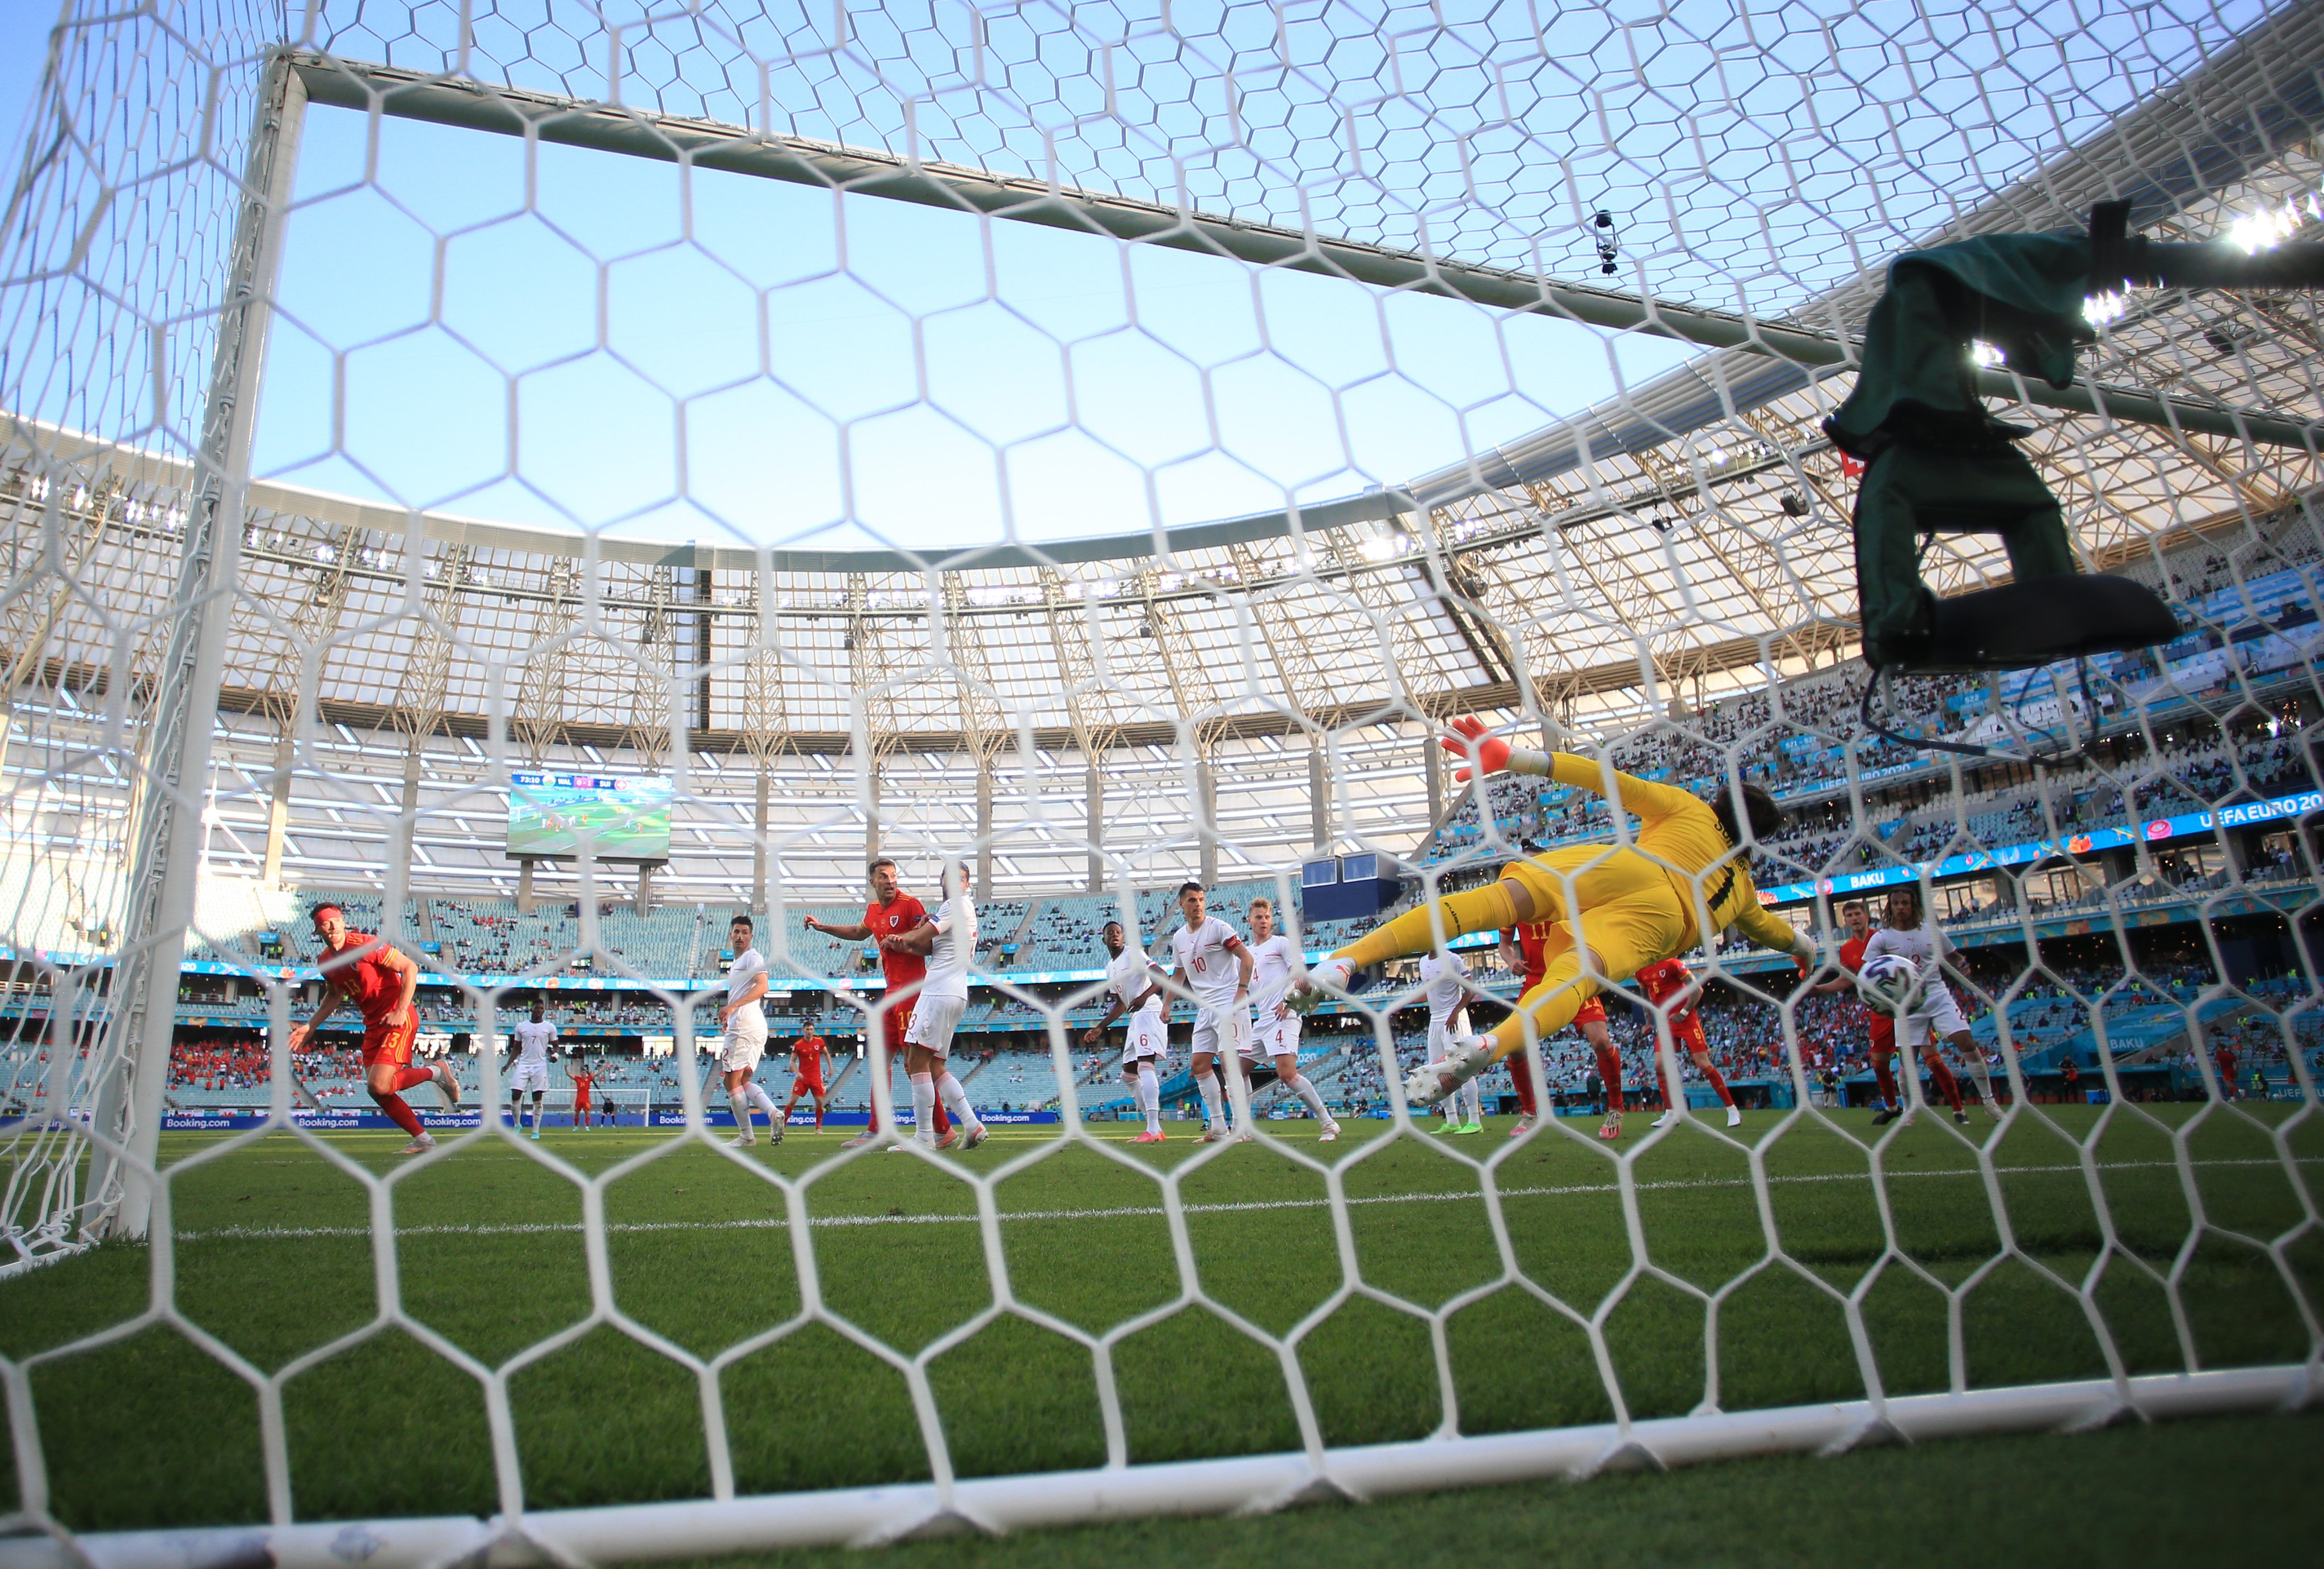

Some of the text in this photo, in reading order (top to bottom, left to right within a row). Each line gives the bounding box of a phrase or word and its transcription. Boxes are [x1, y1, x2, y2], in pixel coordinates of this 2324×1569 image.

[2200, 808, 2247, 828] UEFA
[2247, 799, 2297, 820] EURO
[1850, 872, 1885, 888] BAKU
[1532, 921, 1549, 940] 11
[1192, 957, 1207, 973] 10
[1912, 954, 1922, 968] 2
[1253, 968, 1259, 982] 4
[344, 978, 361, 996] 13
[616, 980, 639, 989] UEFA
[663, 981, 685, 989] 2020
[1652, 981, 1660, 994] 6
[381, 1032, 400, 1048] 13
[531, 1035, 537, 1044] 7
[1140, 1034, 1148, 1047] 6
[1275, 1029, 1283, 1044] 4
[1693, 1028, 1702, 1040] 6
[2110, 1037, 2144, 1049] BAKU
[1296, 1053, 1317, 1064] 020
[167, 1119, 230, 1129] Booking.com
[299, 1117, 359, 1128] Booking.com
[424, 1117, 481, 1128] Booking.com
[981, 1114, 1030, 1123] Booking.com
